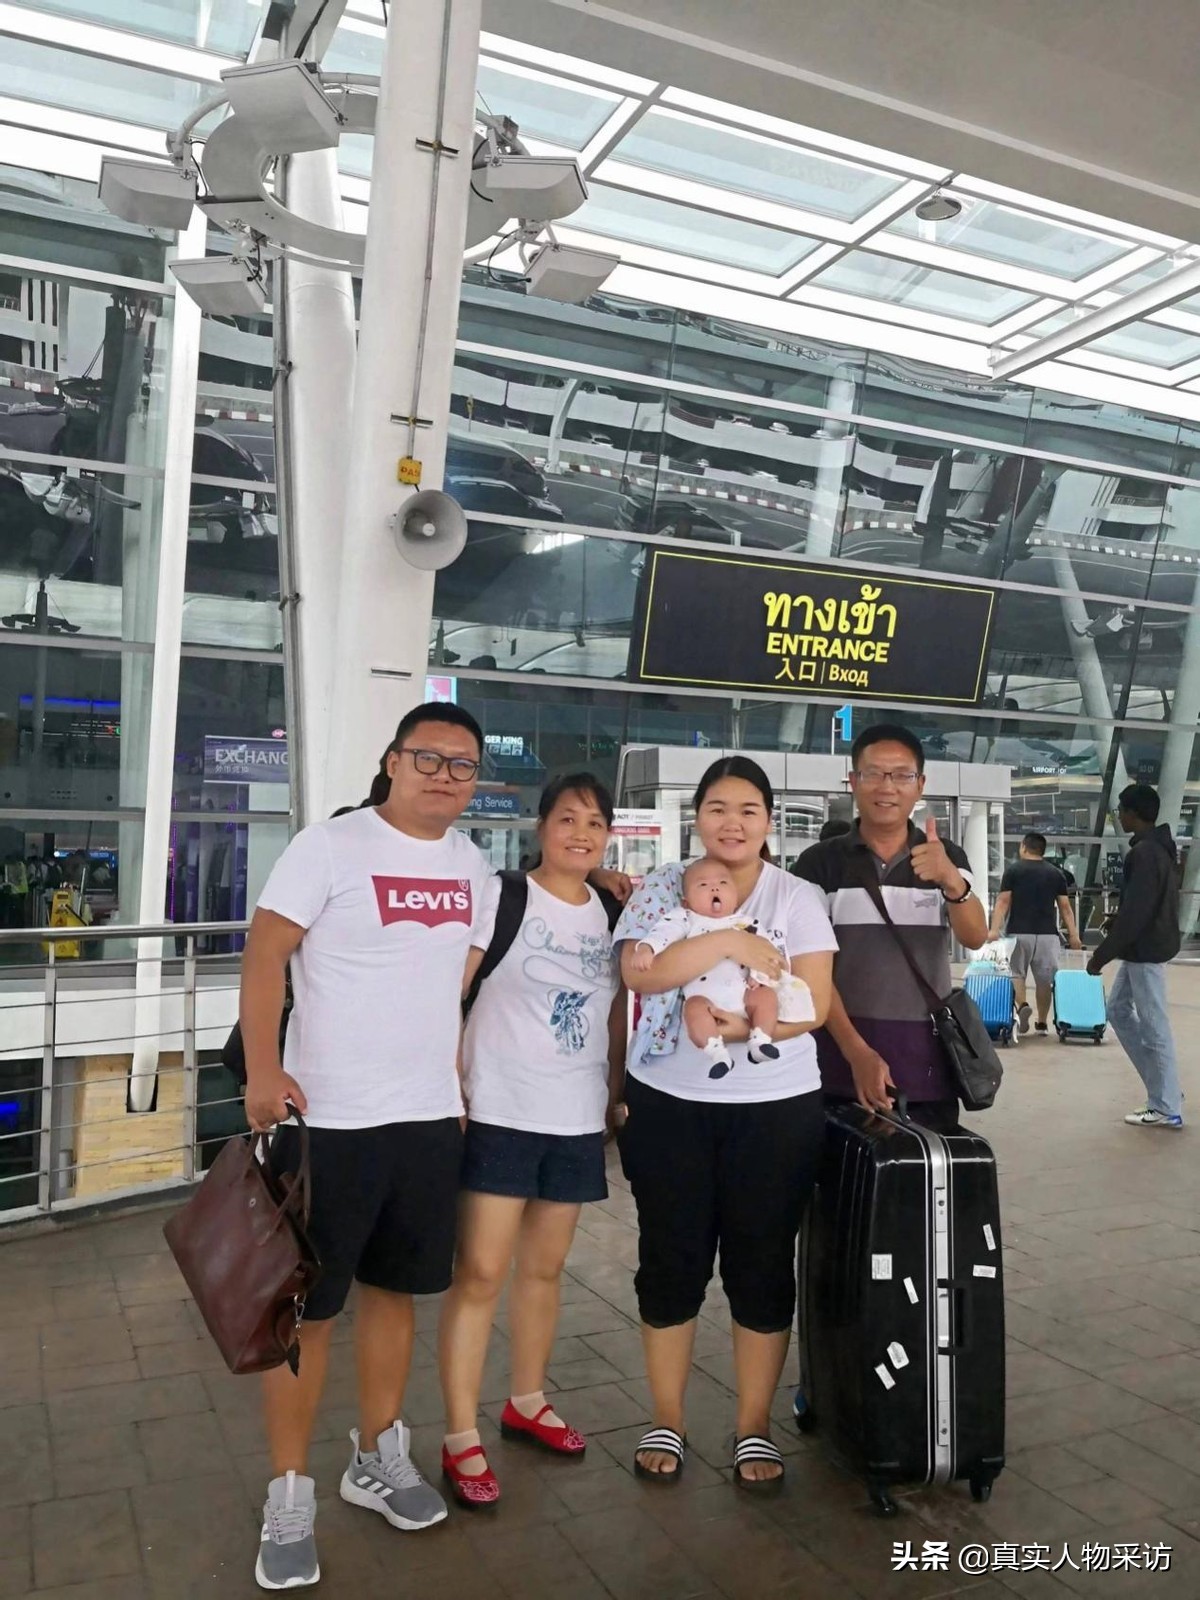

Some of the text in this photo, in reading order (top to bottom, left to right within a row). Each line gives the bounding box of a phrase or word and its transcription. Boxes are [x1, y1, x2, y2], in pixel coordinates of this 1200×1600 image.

[763, 583, 898, 638] ทางเข้า
[766, 632, 891, 663] ENTRANCE
[774, 657, 869, 687] 入口 Вход
[835, 703, 853, 741] 1
[485, 796, 513, 809] Service
